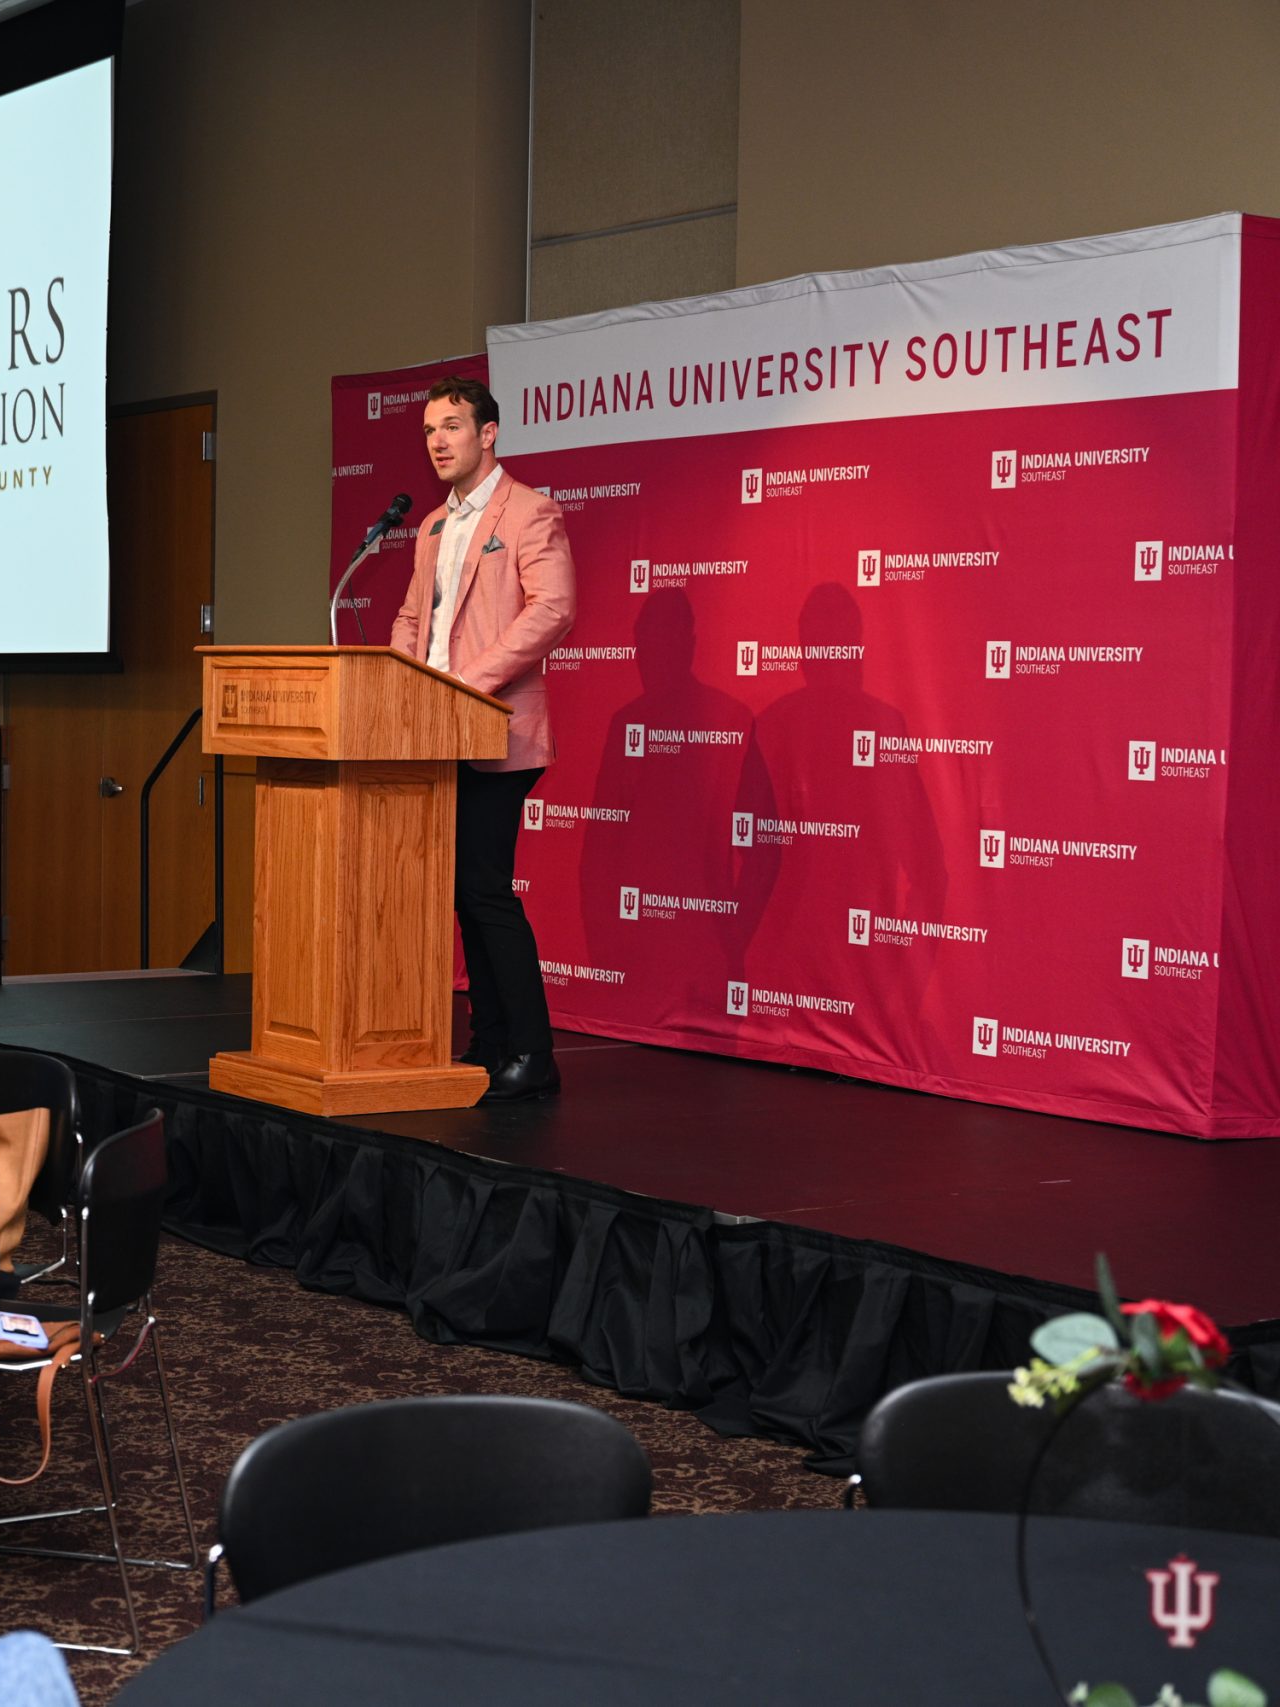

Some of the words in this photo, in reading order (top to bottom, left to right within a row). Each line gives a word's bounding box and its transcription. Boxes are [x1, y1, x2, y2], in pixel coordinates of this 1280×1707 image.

[523, 370, 654, 425] INDIANA
[669, 340, 890, 407] UNIVERSITY
[905, 308, 1172, 382] SOUTHEAST
[383, 393, 410, 406] INDIANA
[1021, 452, 1071, 469] INDIANA
[1075, 447, 1150, 467] UNIVERSITY
[338, 464, 373, 476] UNIVERSITY
[766, 469, 807, 485] INDIANA
[809, 465, 869, 483] UNIVERSITY
[1021, 470, 1066, 482] SOUTHEAST
[554, 487, 588, 502] INDIANA
[590, 483, 641, 498] UNIVERSITY
[766, 486, 803, 497] SOUTHEAST
[561, 502, 585, 512] UTHEAST
[884, 553, 930, 569] INDIANA
[932, 551, 1000, 567] UNIVERSITY
[1167, 545, 1225, 561] INDIANA
[652, 562, 691, 577] INDIANA
[692, 560, 749, 575] UNIVERSITY
[884, 570, 925, 581] SOUTHEAST
[1167, 563, 1218, 575] SOUTHEAST
[652, 578, 687, 588] SOUTHEAST
[585, 646, 637, 660] UNIVERSITY
[761, 646, 803, 660] INDIANA
[804, 646, 865, 660] UNIVERSITY
[1015, 646, 1066, 661] INDIANA
[1068, 646, 1143, 662] UNIVERSITY
[549, 661, 580, 671] SOUTHEAST
[761, 661, 798, 671] SOUTHEAST
[1015, 663, 1060, 675] SOUTHEAST
[648, 729, 685, 743] INDIANA
[688, 730, 744, 745] UNIVERSITY
[648, 745, 680, 754] SOUTHEAST
[879, 736, 923, 752] INDIANA
[925, 738, 993, 755] UNIVERSITY
[879, 753, 918, 764] SOUTHEAST
[1161, 748, 1216, 765] INDIANA
[1161, 765, 1210, 778] SOUTHEAST
[545, 804, 579, 819] INDIANA
[580, 807, 631, 822] UNIVERSITY
[545, 818, 575, 829] SOUTHEAST
[757, 818, 797, 834] INDIANA
[800, 822, 861, 838] UNIVERSITY
[757, 834, 793, 845] SOUTHEAST
[1009, 837, 1060, 855] INDIANA
[1062, 841, 1138, 860] UNIVERSITY
[1009, 854, 1054, 867] SOUTHEAST
[642, 893, 680, 909] INDIANA
[682, 896, 739, 915] UNIVERSITY
[642, 908, 676, 920] SOUTHEAST
[874, 916, 918, 935] INDIANA
[921, 922, 988, 943] UNIVERSITY
[874, 932, 913, 947] SOUTHEAST
[1154, 946, 1209, 967] INDIANA
[574, 965, 626, 985] UNIVERSITY
[1154, 965, 1202, 980] SOUTHEAST
[752, 988, 794, 1007] INDIANA
[796, 994, 855, 1016] UNIVERSITY
[752, 1004, 790, 1017] SOUTHEAST
[1002, 1026, 1052, 1047] INDIANA
[1055, 1033, 1131, 1057] UNIVERSITY
[1002, 1043, 1047, 1059] SOUTHEAST
